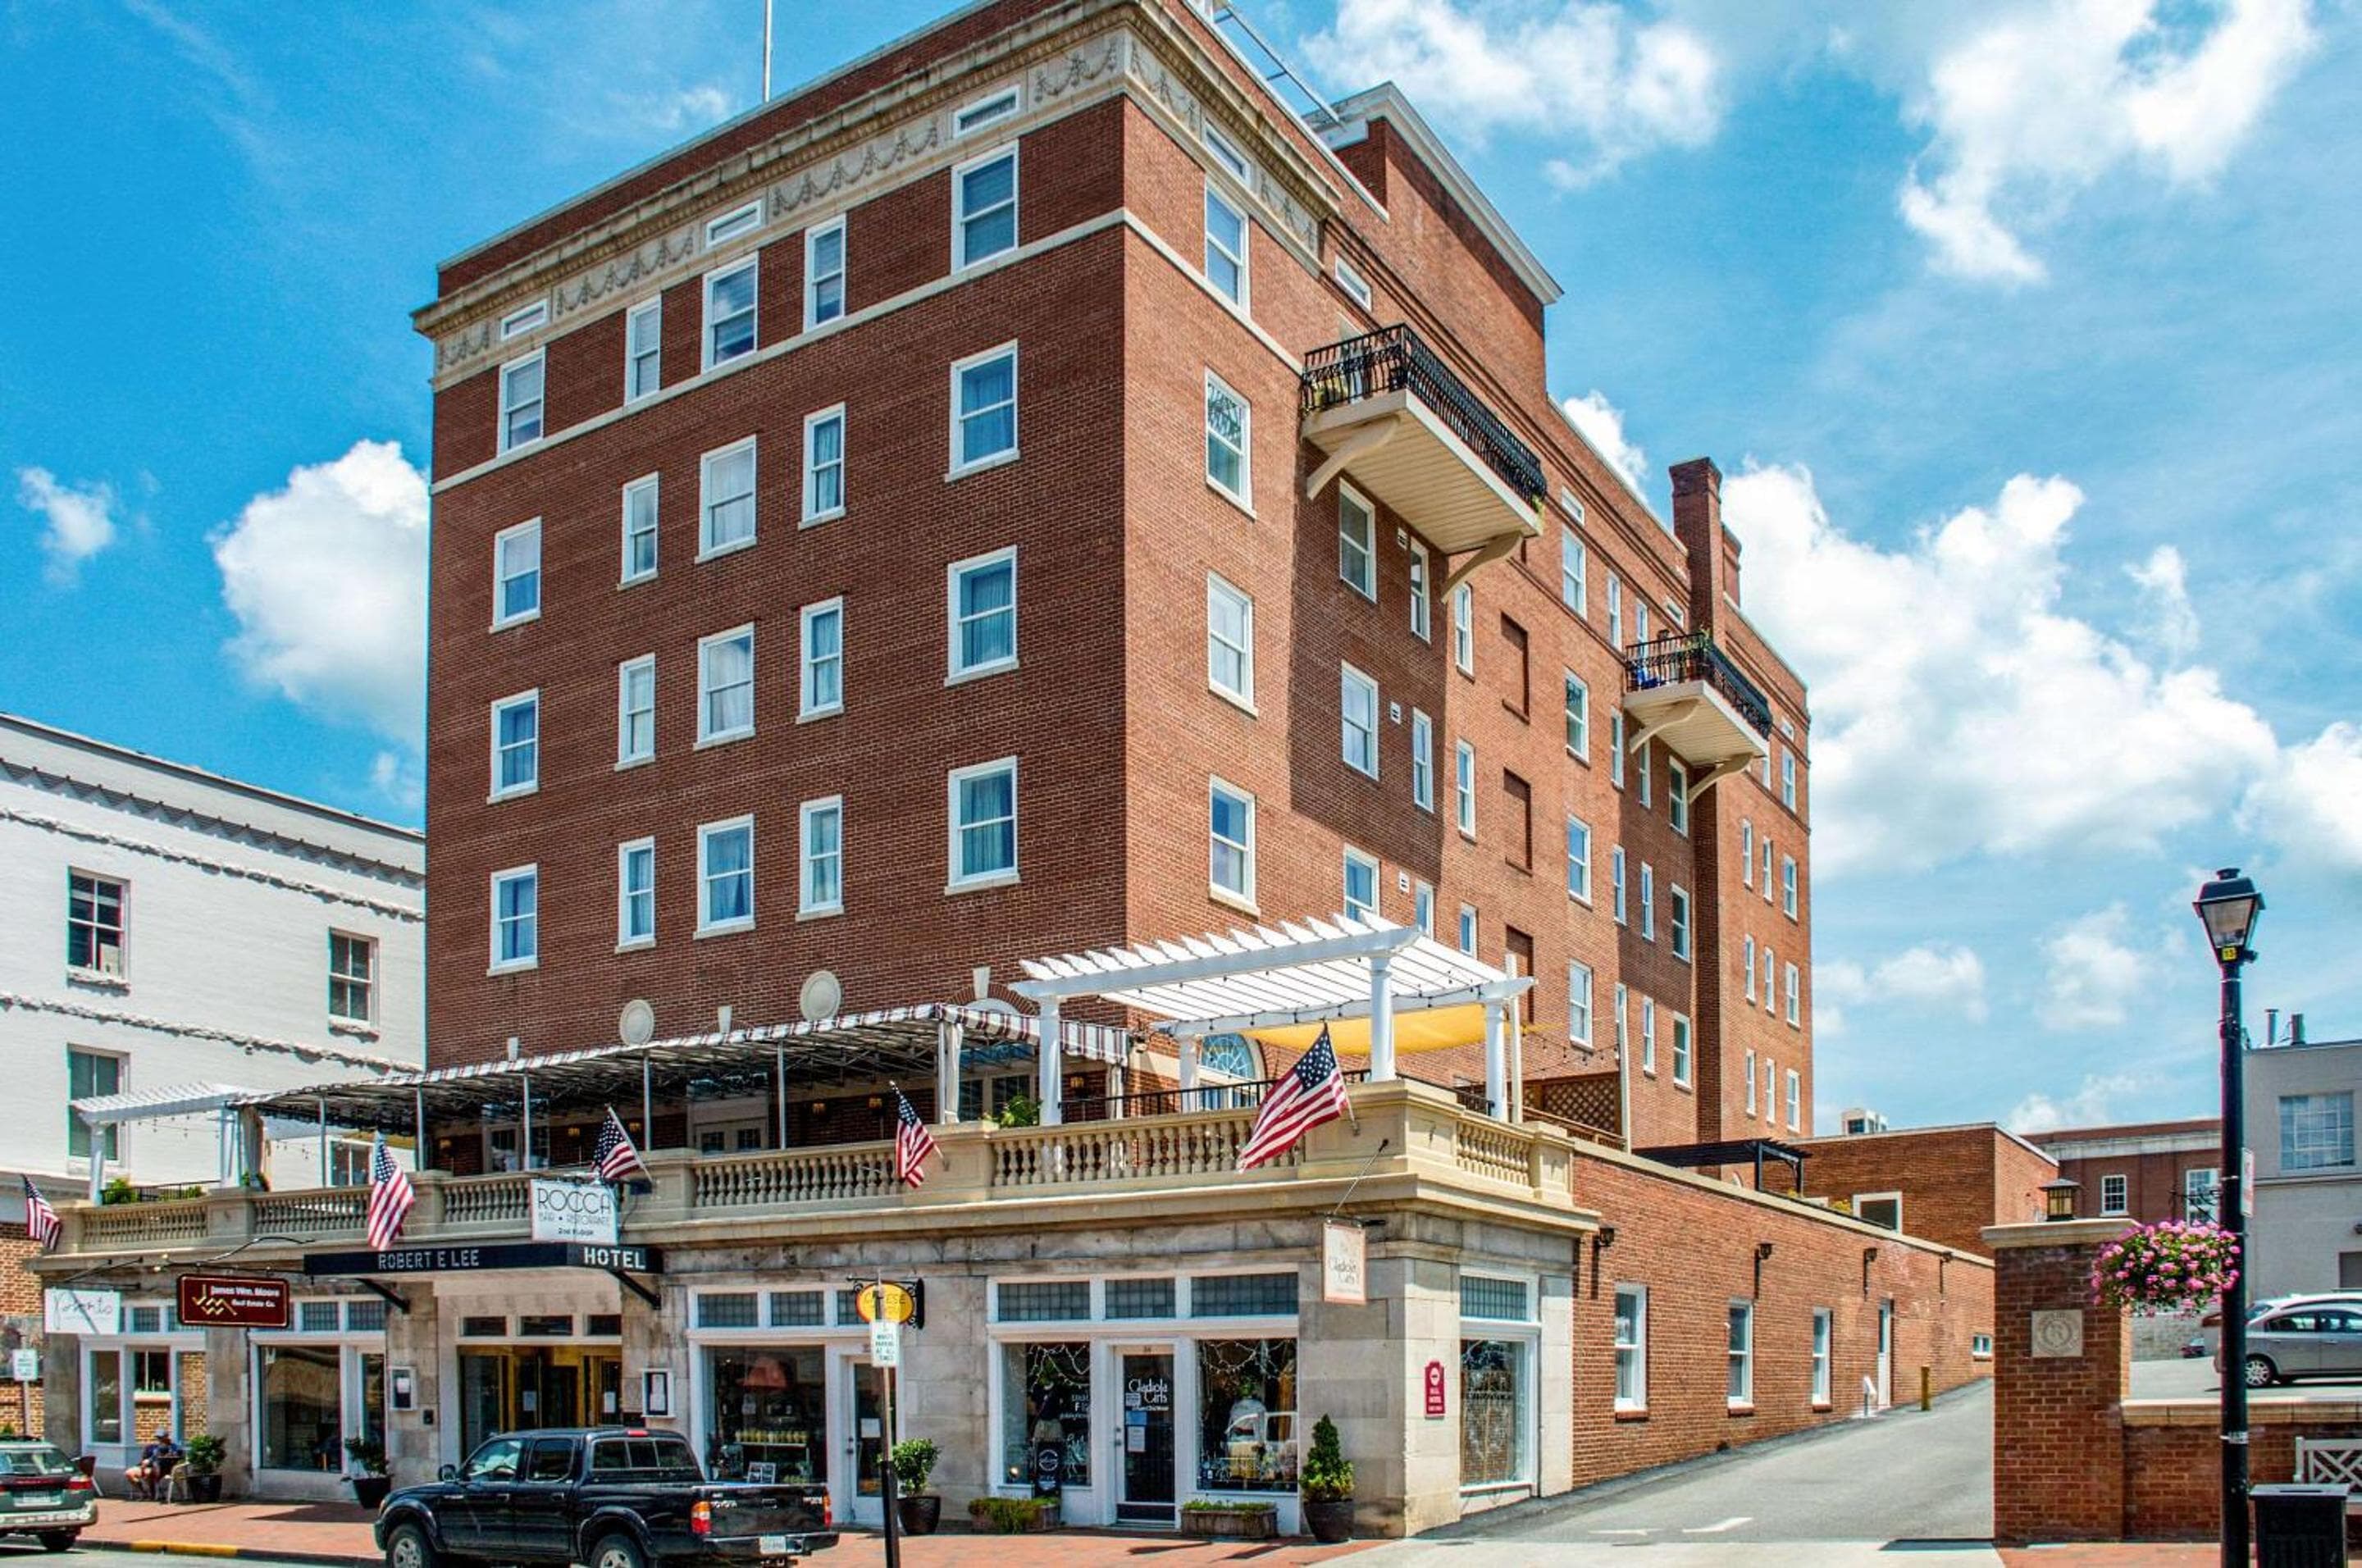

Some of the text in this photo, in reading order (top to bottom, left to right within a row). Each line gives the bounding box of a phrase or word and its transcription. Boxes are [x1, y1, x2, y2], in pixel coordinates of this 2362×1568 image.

[537, 1187, 610, 1215] ROCCA
[378, 1248, 480, 1270] ROBERT E LEE
[583, 1247, 645, 1270] HOTEL
